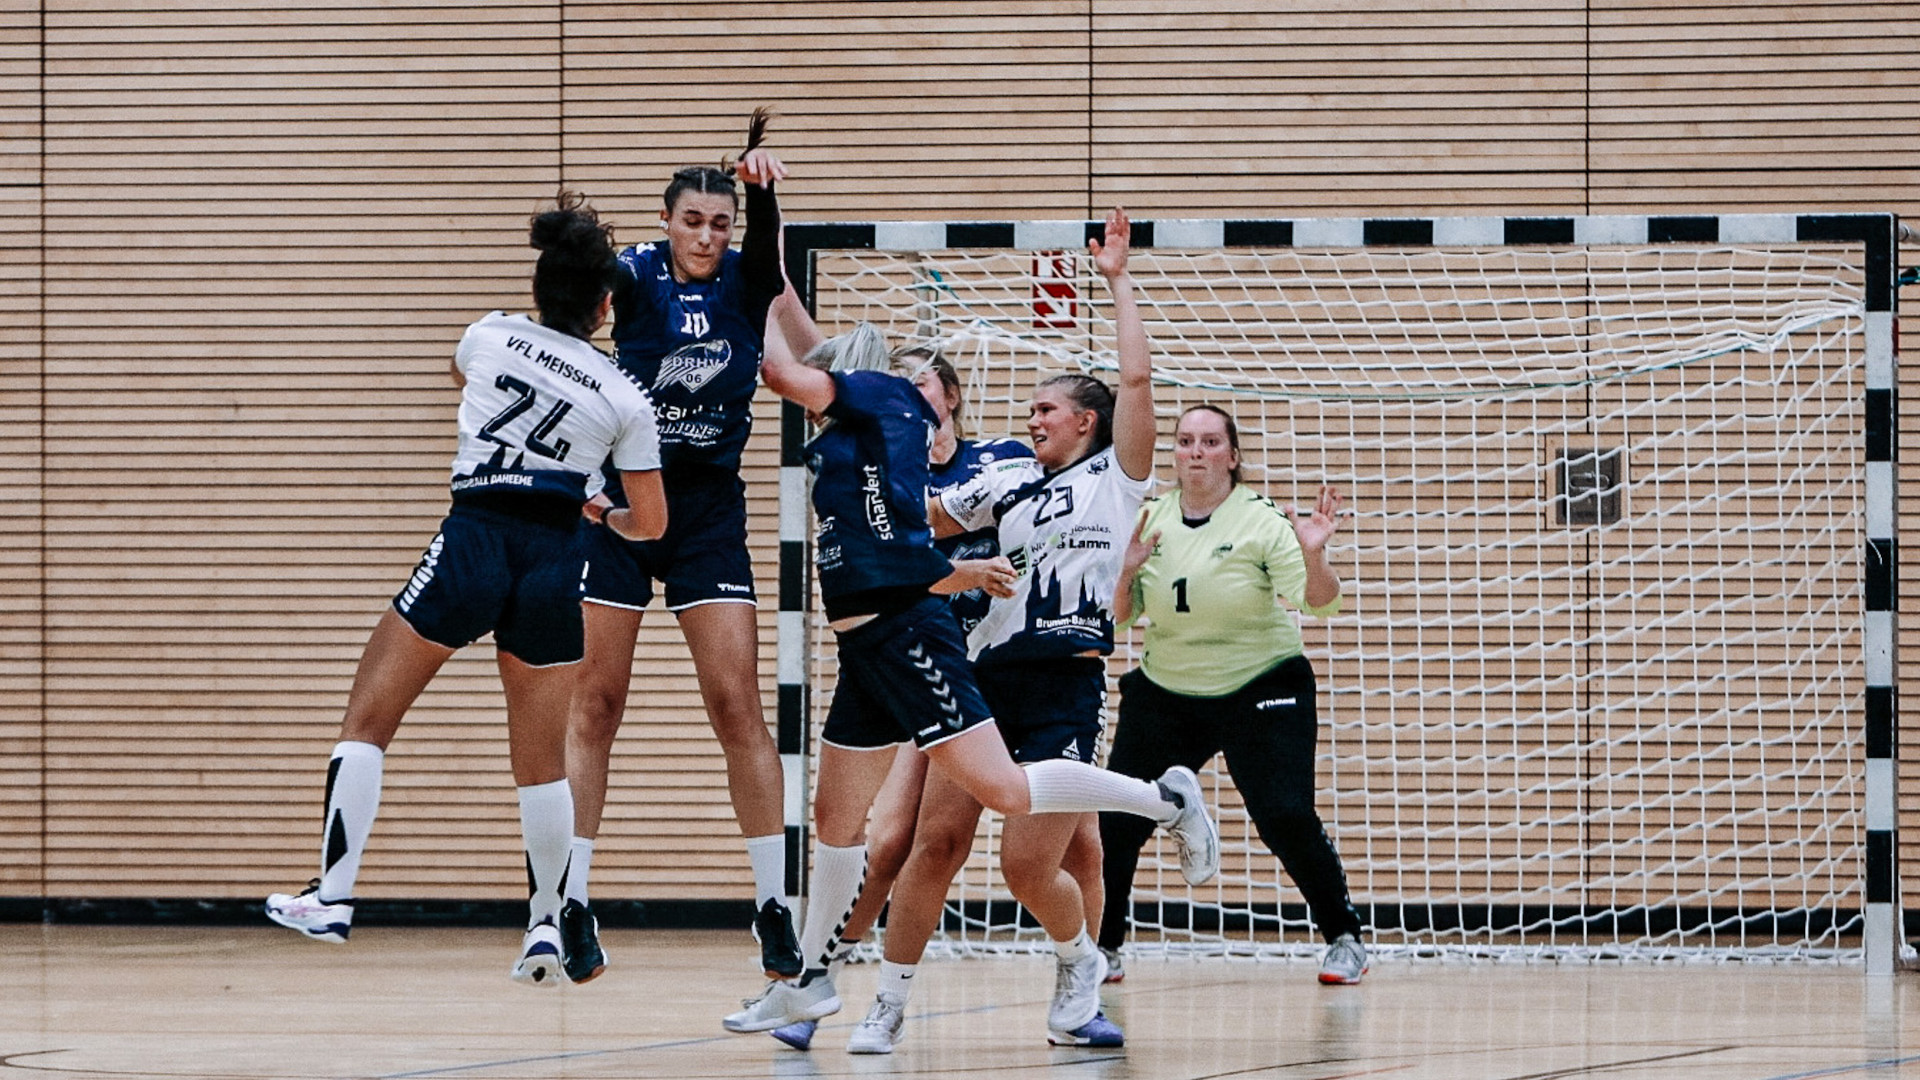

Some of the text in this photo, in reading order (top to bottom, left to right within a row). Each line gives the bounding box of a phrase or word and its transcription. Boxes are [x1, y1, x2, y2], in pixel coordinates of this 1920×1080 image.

[680, 311, 711, 339] 10
[506, 335, 602, 393] VFL MEISSEN
[672, 356, 720, 370] DRHV
[686, 373, 702, 384] 06
[476, 373, 574, 463] 24
[862, 464, 895, 541] schandert
[1031, 485, 1075, 527] 23
[1069, 538, 1111, 551] Lamm
[1171, 577, 1191, 613] 1
